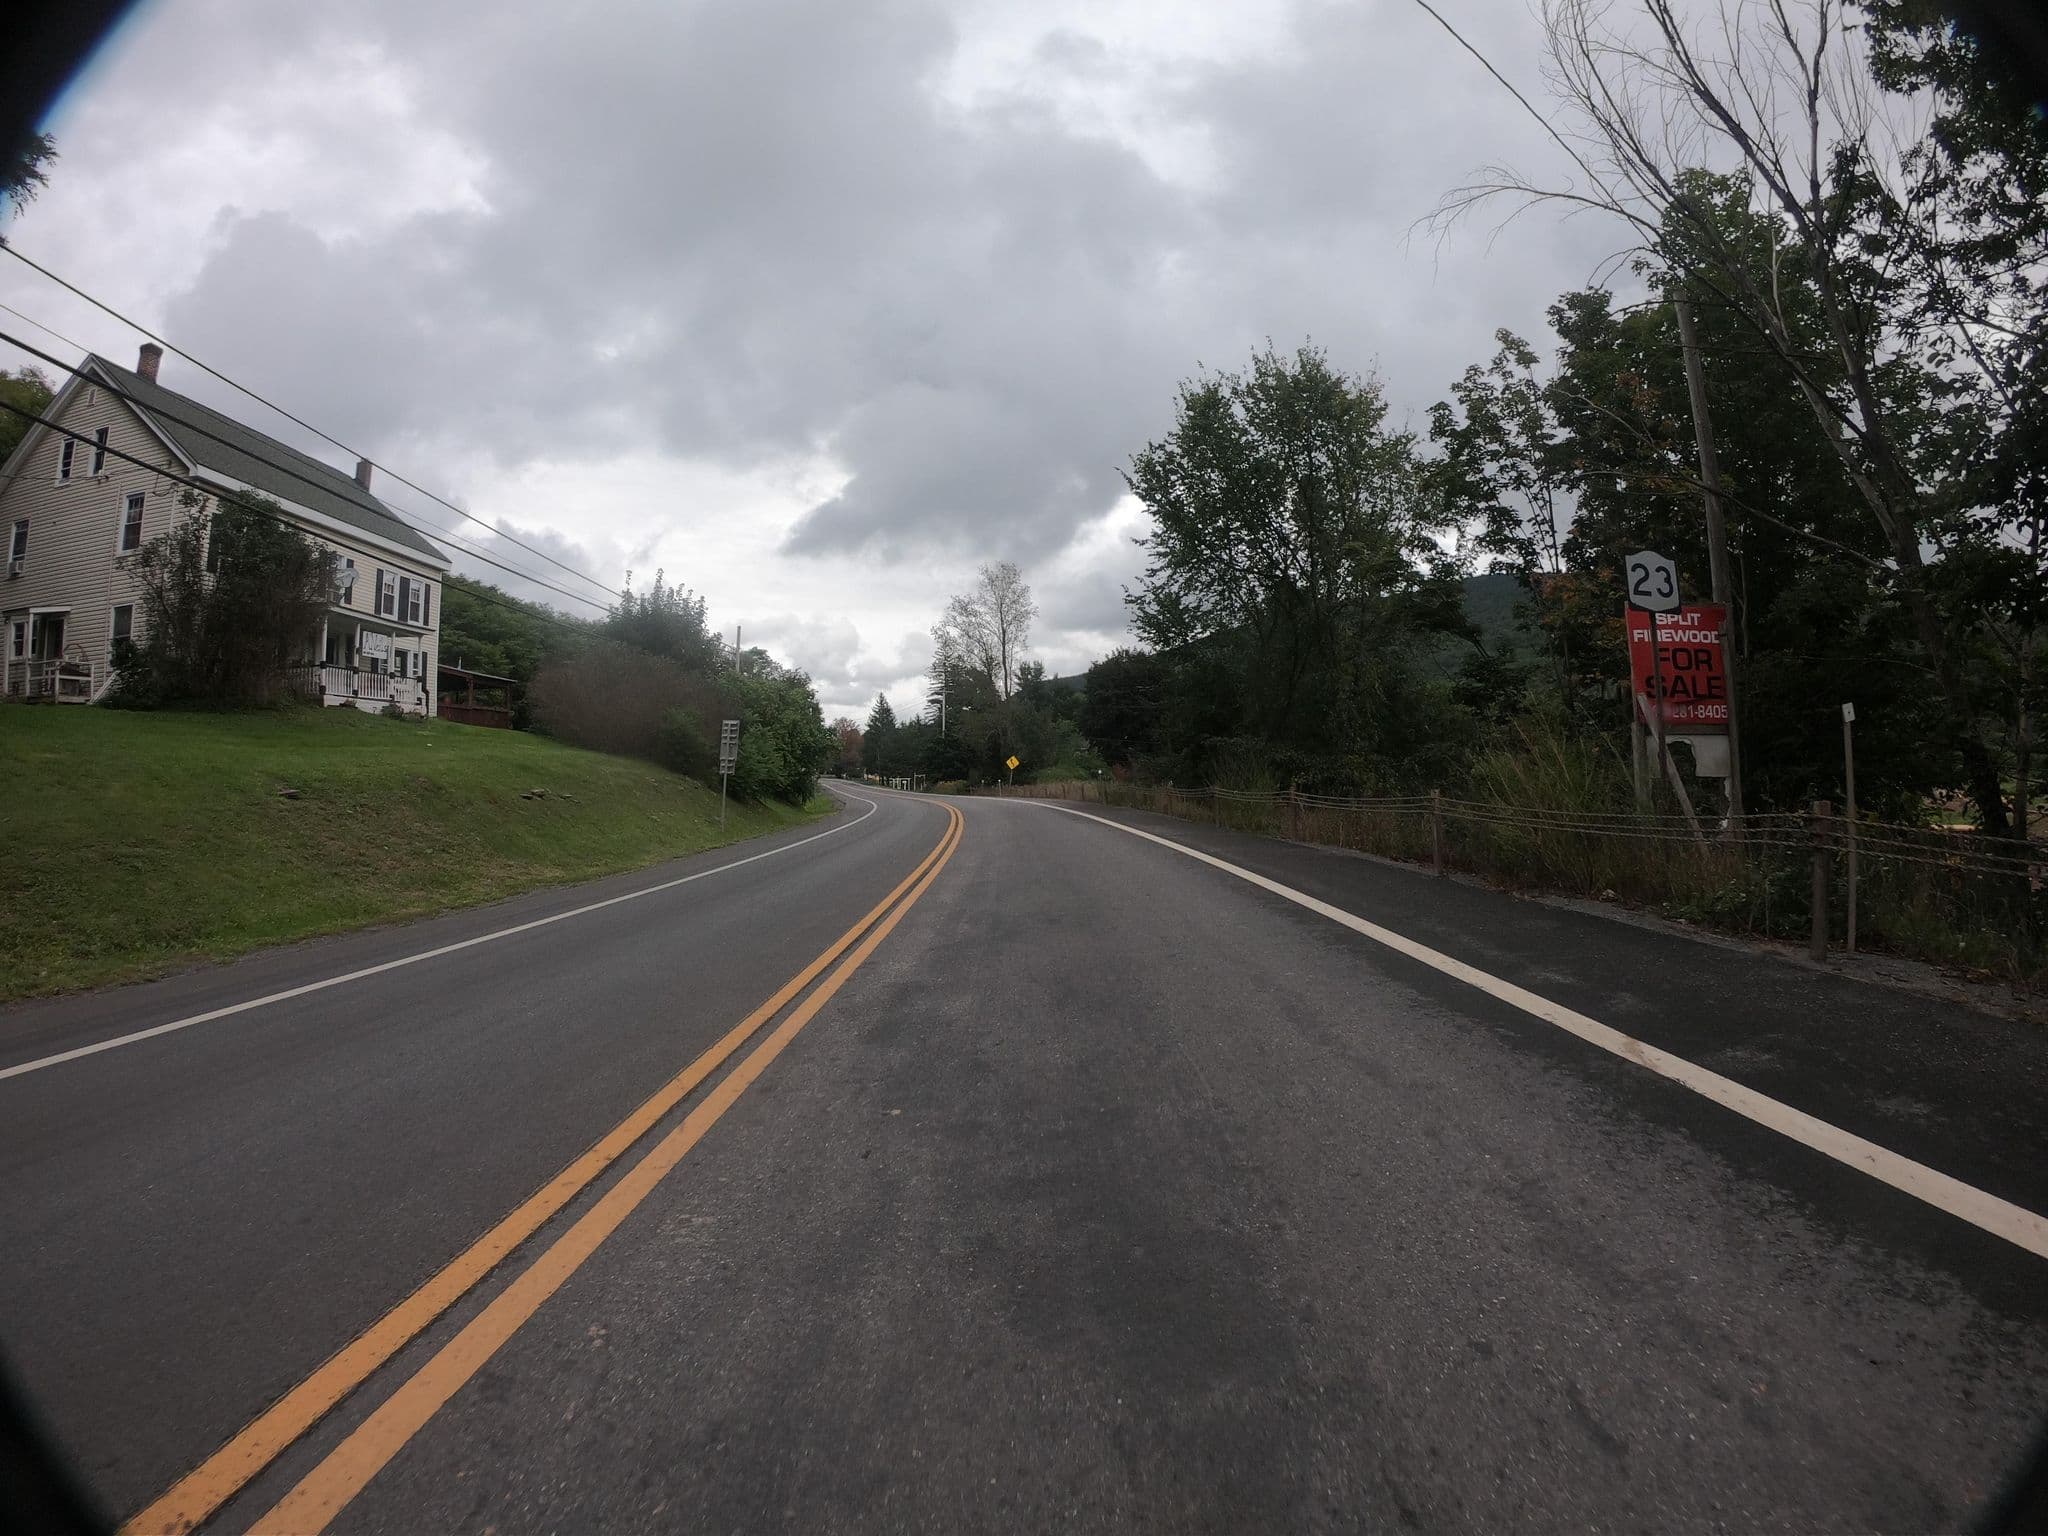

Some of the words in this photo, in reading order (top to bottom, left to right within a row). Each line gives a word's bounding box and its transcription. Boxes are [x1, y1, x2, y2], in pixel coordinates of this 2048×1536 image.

[1630, 563, 1674, 598] 23
[1655, 612, 1701, 626] SPLIT
[1656, 647, 1713, 672] FOR
[1645, 674, 1725, 699] SALE
